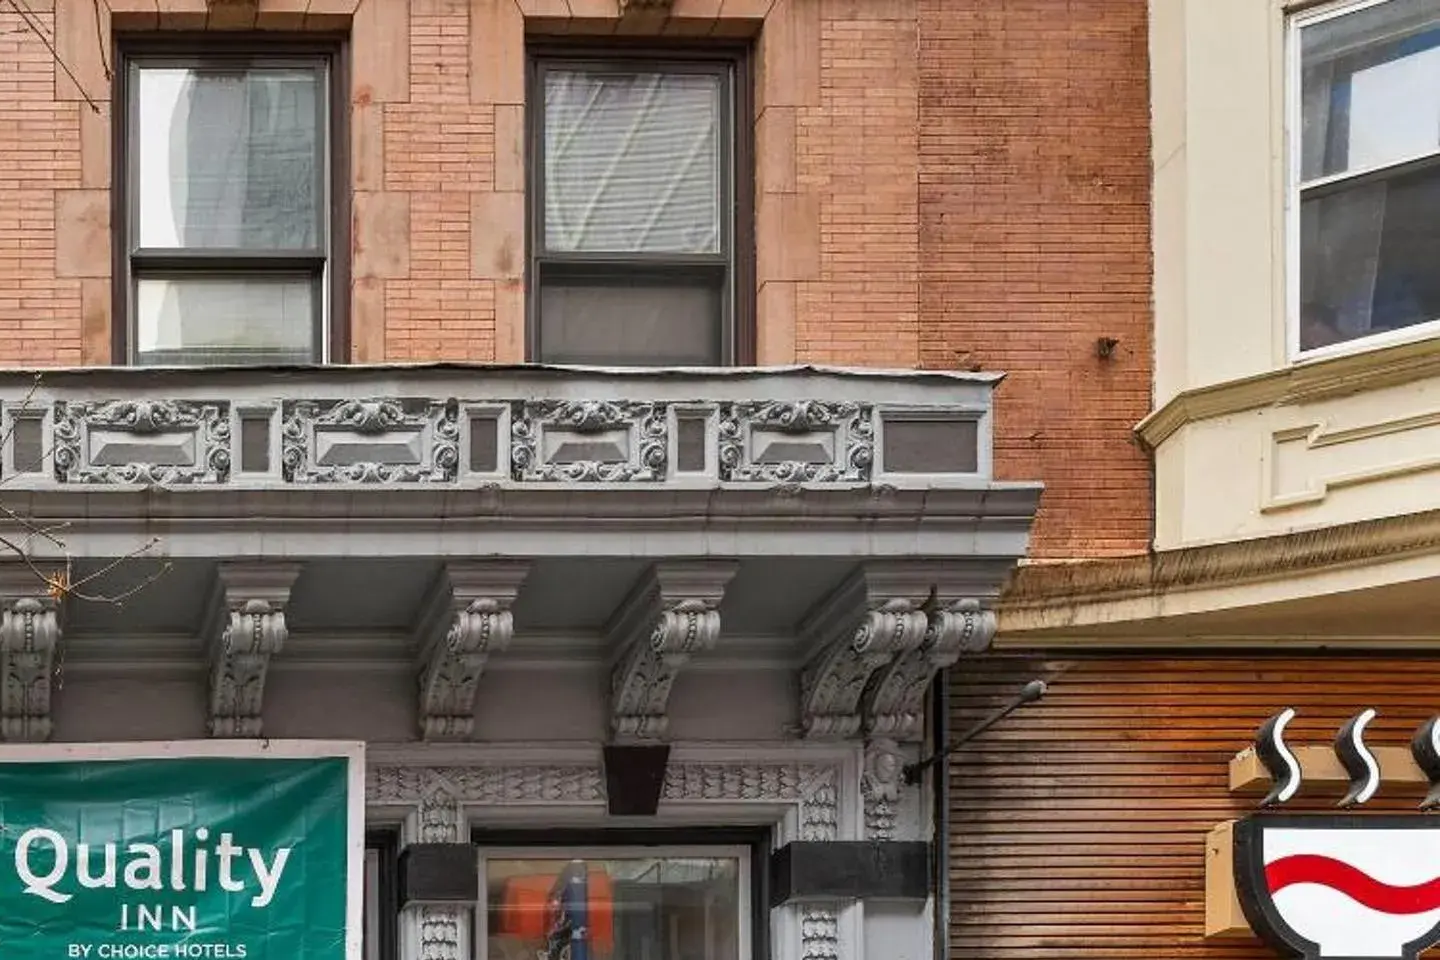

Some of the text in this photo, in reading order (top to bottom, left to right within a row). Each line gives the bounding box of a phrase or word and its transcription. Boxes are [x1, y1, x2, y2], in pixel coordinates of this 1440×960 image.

[15, 827, 291, 907] Quality
[120, 903, 197, 931] INN
[68, 943, 247, 959] BY CHOICE HOTELS
